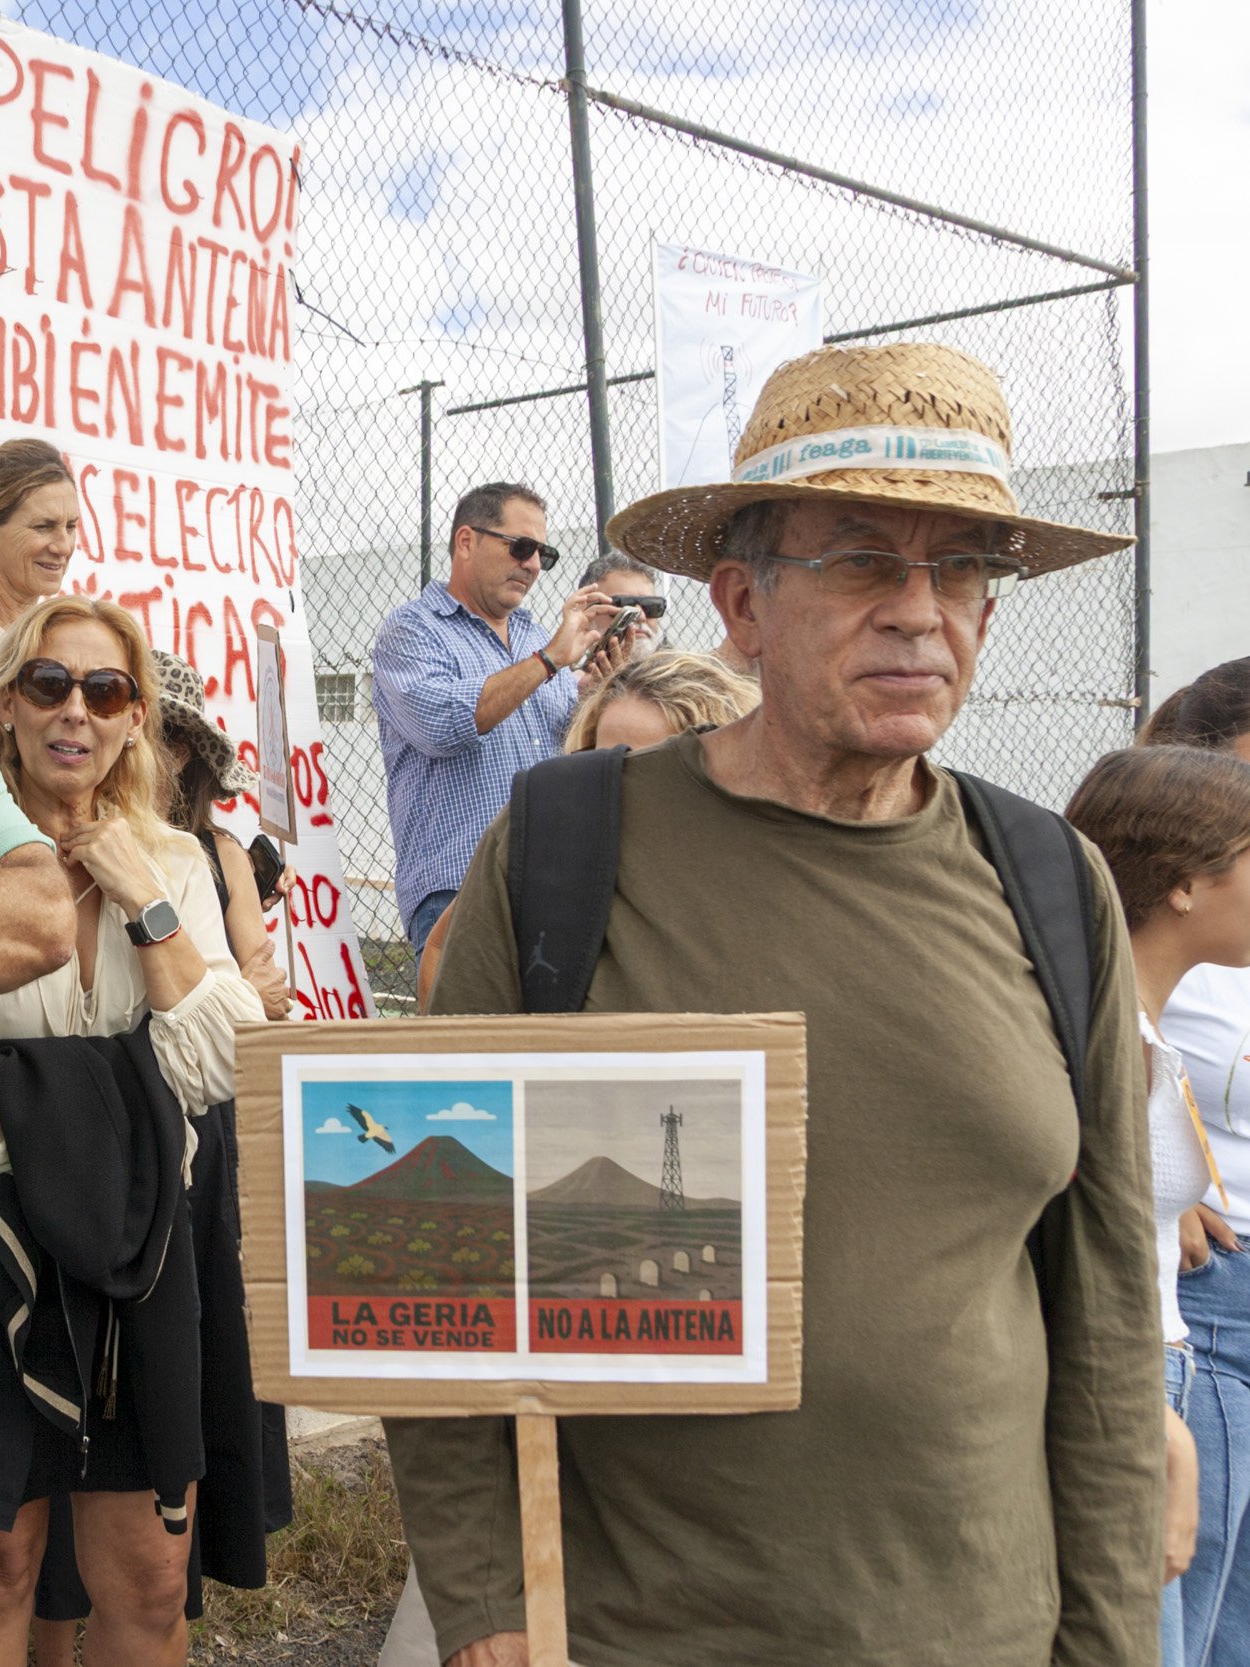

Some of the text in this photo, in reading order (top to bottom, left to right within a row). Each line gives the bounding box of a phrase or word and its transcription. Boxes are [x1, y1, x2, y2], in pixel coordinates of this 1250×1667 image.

[106, 203, 291, 363] ANTENA
[741, 293, 798, 328] FUTURO?
[799, 437, 872, 463] feaga
[112, 468, 299, 589] ELECTRO
[331, 1301, 496, 1328] LA GERIA
[537, 1306, 736, 1342] NO A LA ANTENA
[332, 1328, 495, 1348] NO SE VENDE
